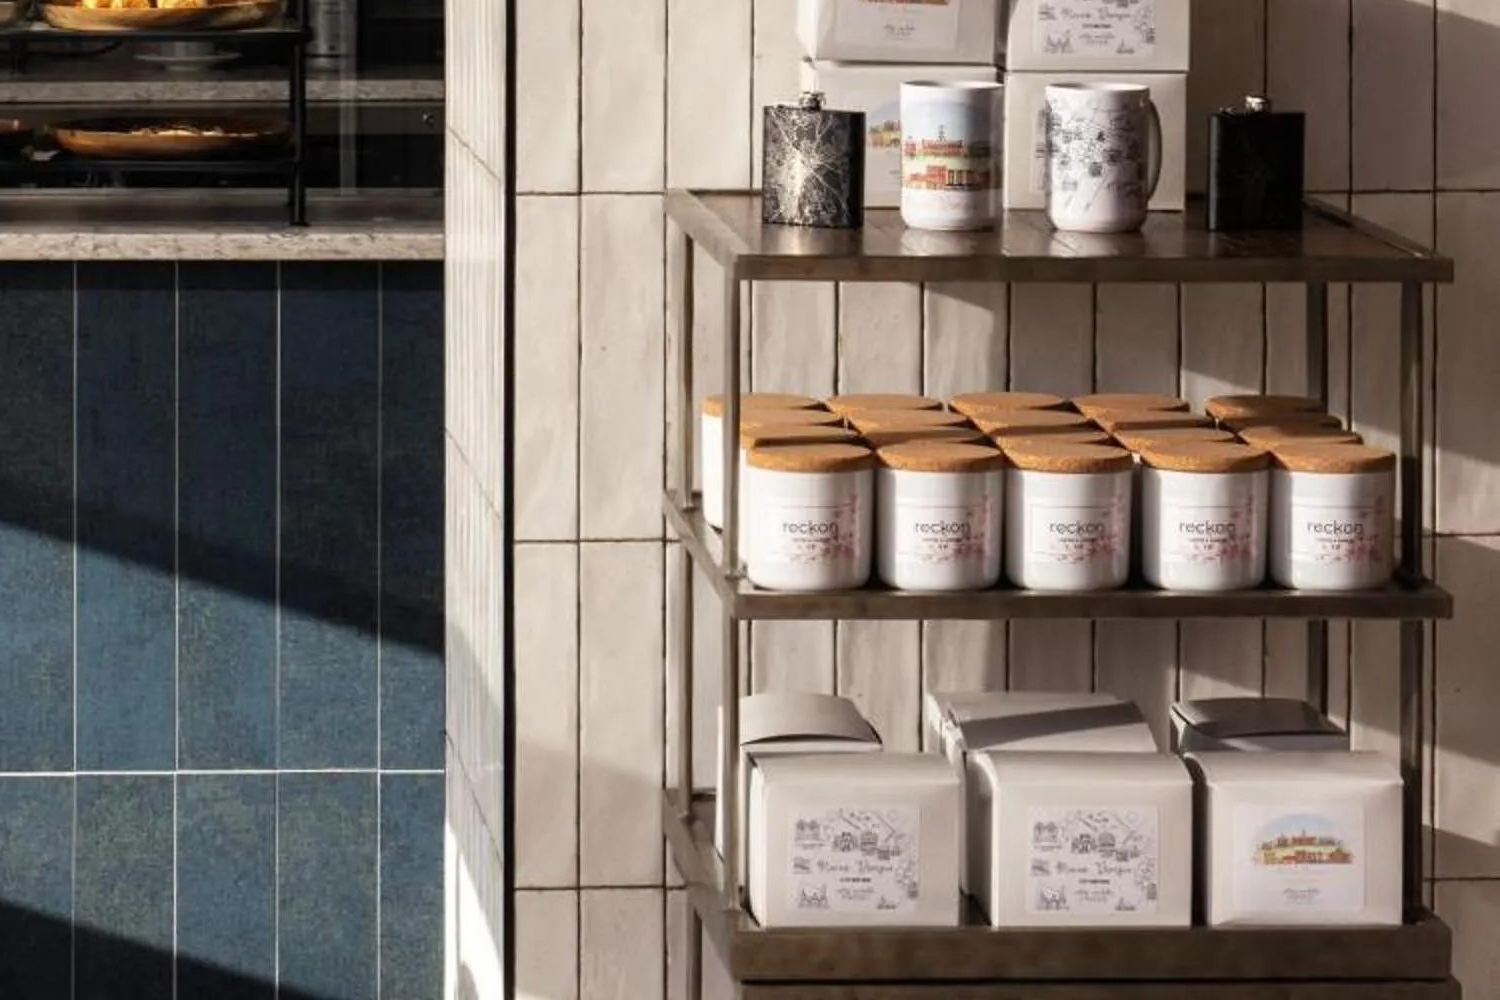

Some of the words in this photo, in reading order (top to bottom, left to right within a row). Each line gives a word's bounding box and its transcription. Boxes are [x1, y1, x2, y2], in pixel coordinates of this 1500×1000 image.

[782, 520, 838, 534] reckon
[915, 520, 970, 534] reckon
[1049, 520, 1105, 535] reckon
